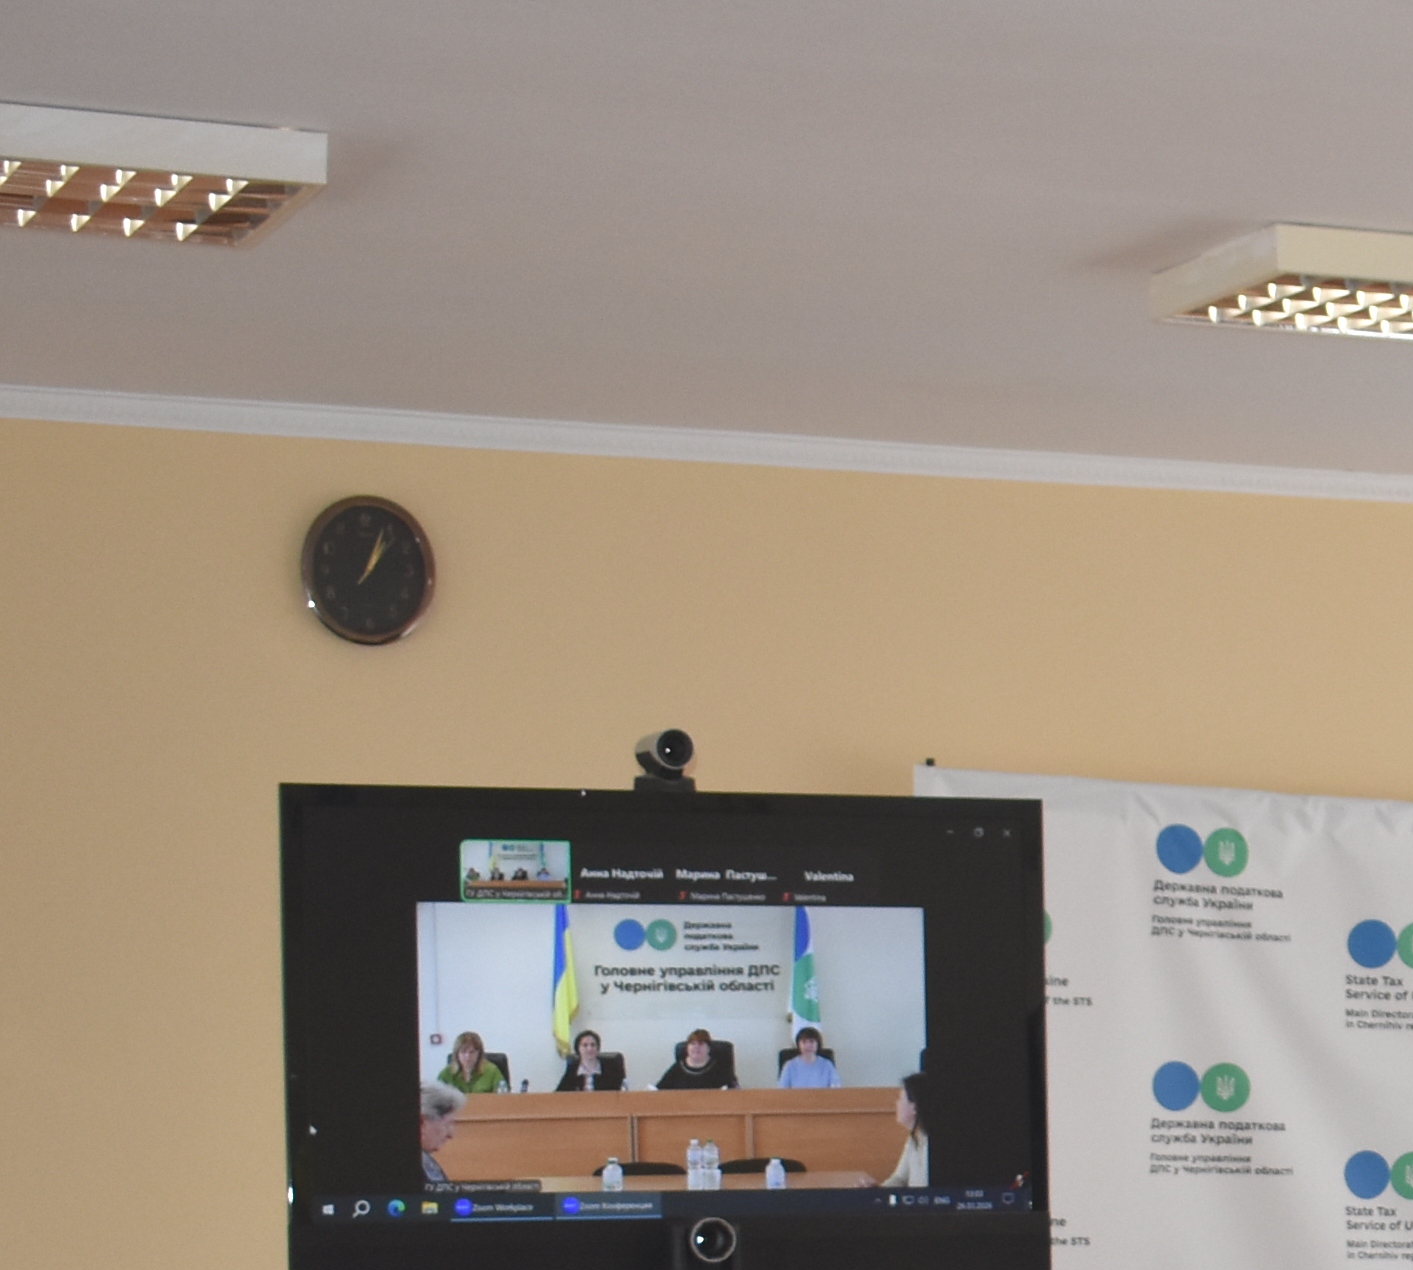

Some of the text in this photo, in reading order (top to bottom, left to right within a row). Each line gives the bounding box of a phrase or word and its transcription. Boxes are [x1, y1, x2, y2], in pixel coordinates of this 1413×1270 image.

[581, 868, 609, 878] Анна
[675, 868, 721, 881] Марина
[804, 871, 854, 882] Valentina
[1154, 880, 1283, 898] Державна податкова
[1153, 896, 1253, 911] служба України
[684, 921, 731, 930] Державна
[723, 943, 759, 951] України
[594, 964, 780, 978] Головне управління ДПС
[1345, 974, 1403, 986] State Tax
[601, 981, 774, 994] у Чернігівській області
[1345, 989, 1391, 1000] Service
[1395, 990, 1408, 1000] of
[1345, 1009, 1369, 1017] Main
[1346, 1020, 1355, 1028] in
[1357, 1020, 1401, 1029] Chernihiv
[1151, 1118, 1285, 1131] Державна податкова
[1152, 1133, 1252, 1145] служба України
[1151, 1153, 1251, 1163] Головне управління
[1150, 1164, 1171, 1174] ДПС
[1182, 1165, 1251, 1175] Чернігівській
[1255, 1166, 1293, 1175] області
[1345, 1206, 1396, 1216] State Tax
[1346, 1220, 1385, 1230] Service
[1389, 1221, 1401, 1230] of
[1347, 1240, 1368, 1248] Main
